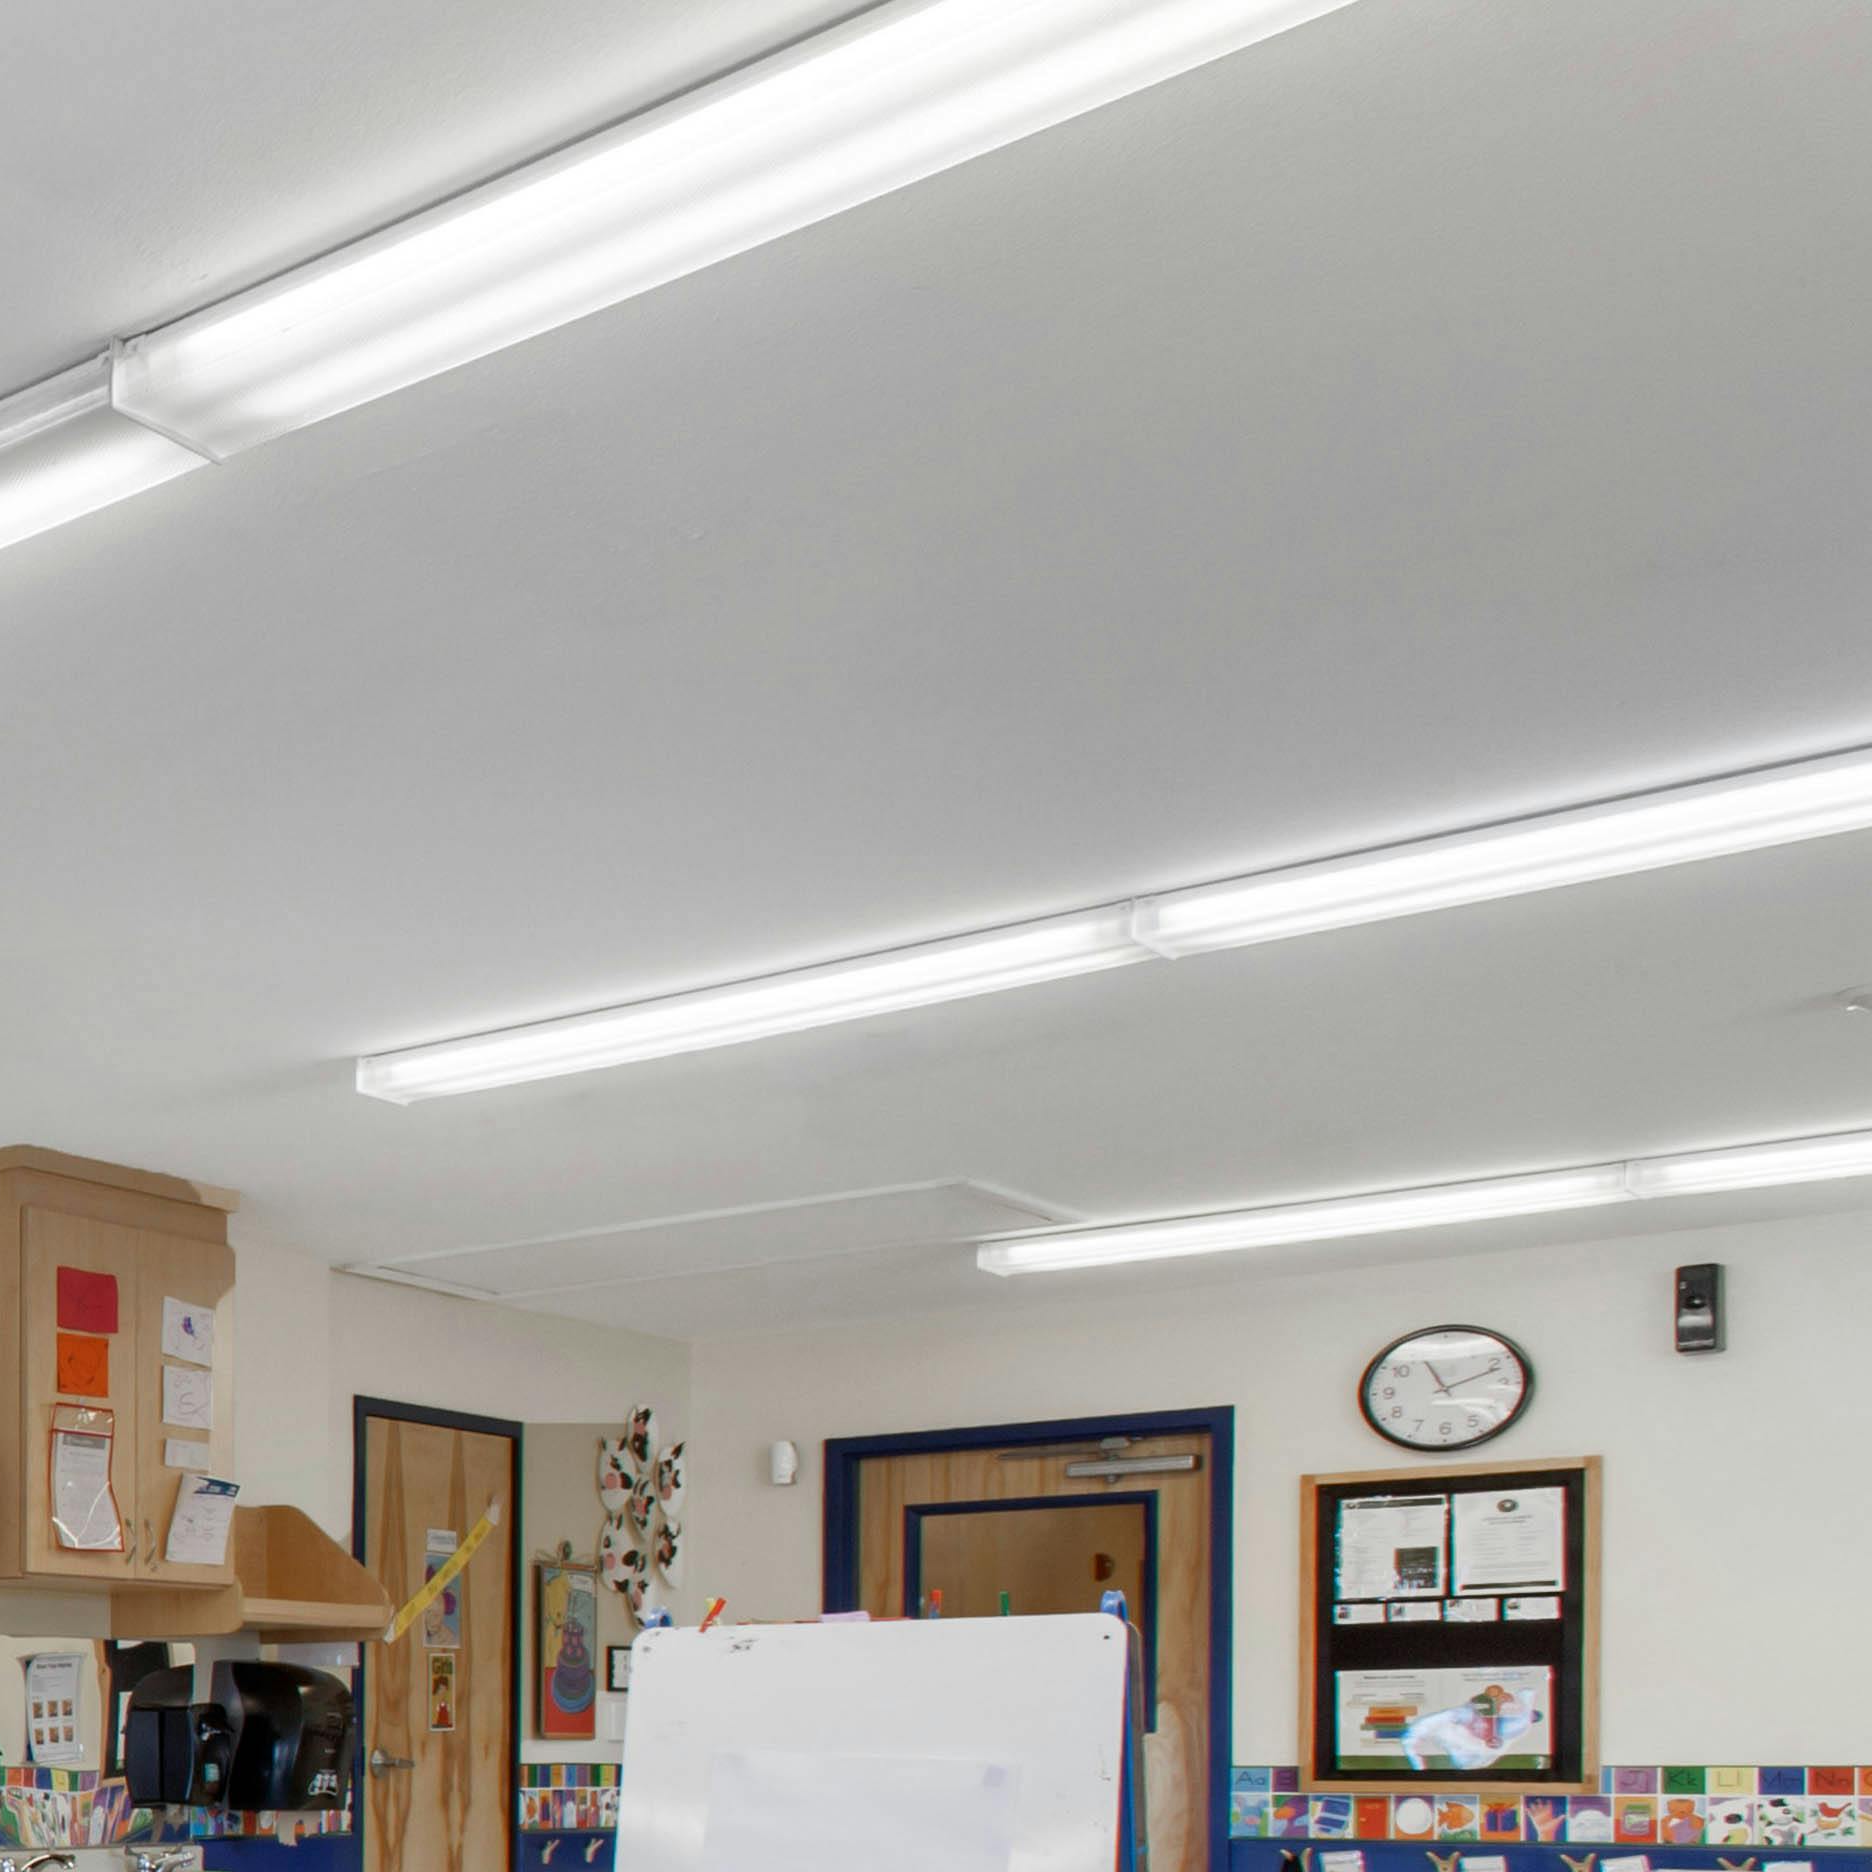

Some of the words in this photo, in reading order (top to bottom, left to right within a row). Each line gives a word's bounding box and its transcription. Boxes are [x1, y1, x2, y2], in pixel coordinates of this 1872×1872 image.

[1392, 1364, 1410, 1378] 10
[1383, 1387, 1395, 1399] 9
[1392, 1406, 1402, 1418] 8
[1413, 1419, 1424, 1432] 7
[1467, 1415, 1479, 1428] 5
[1440, 1422, 1452, 1435] 6
[1236, 1772, 1265, 1786] Aa
